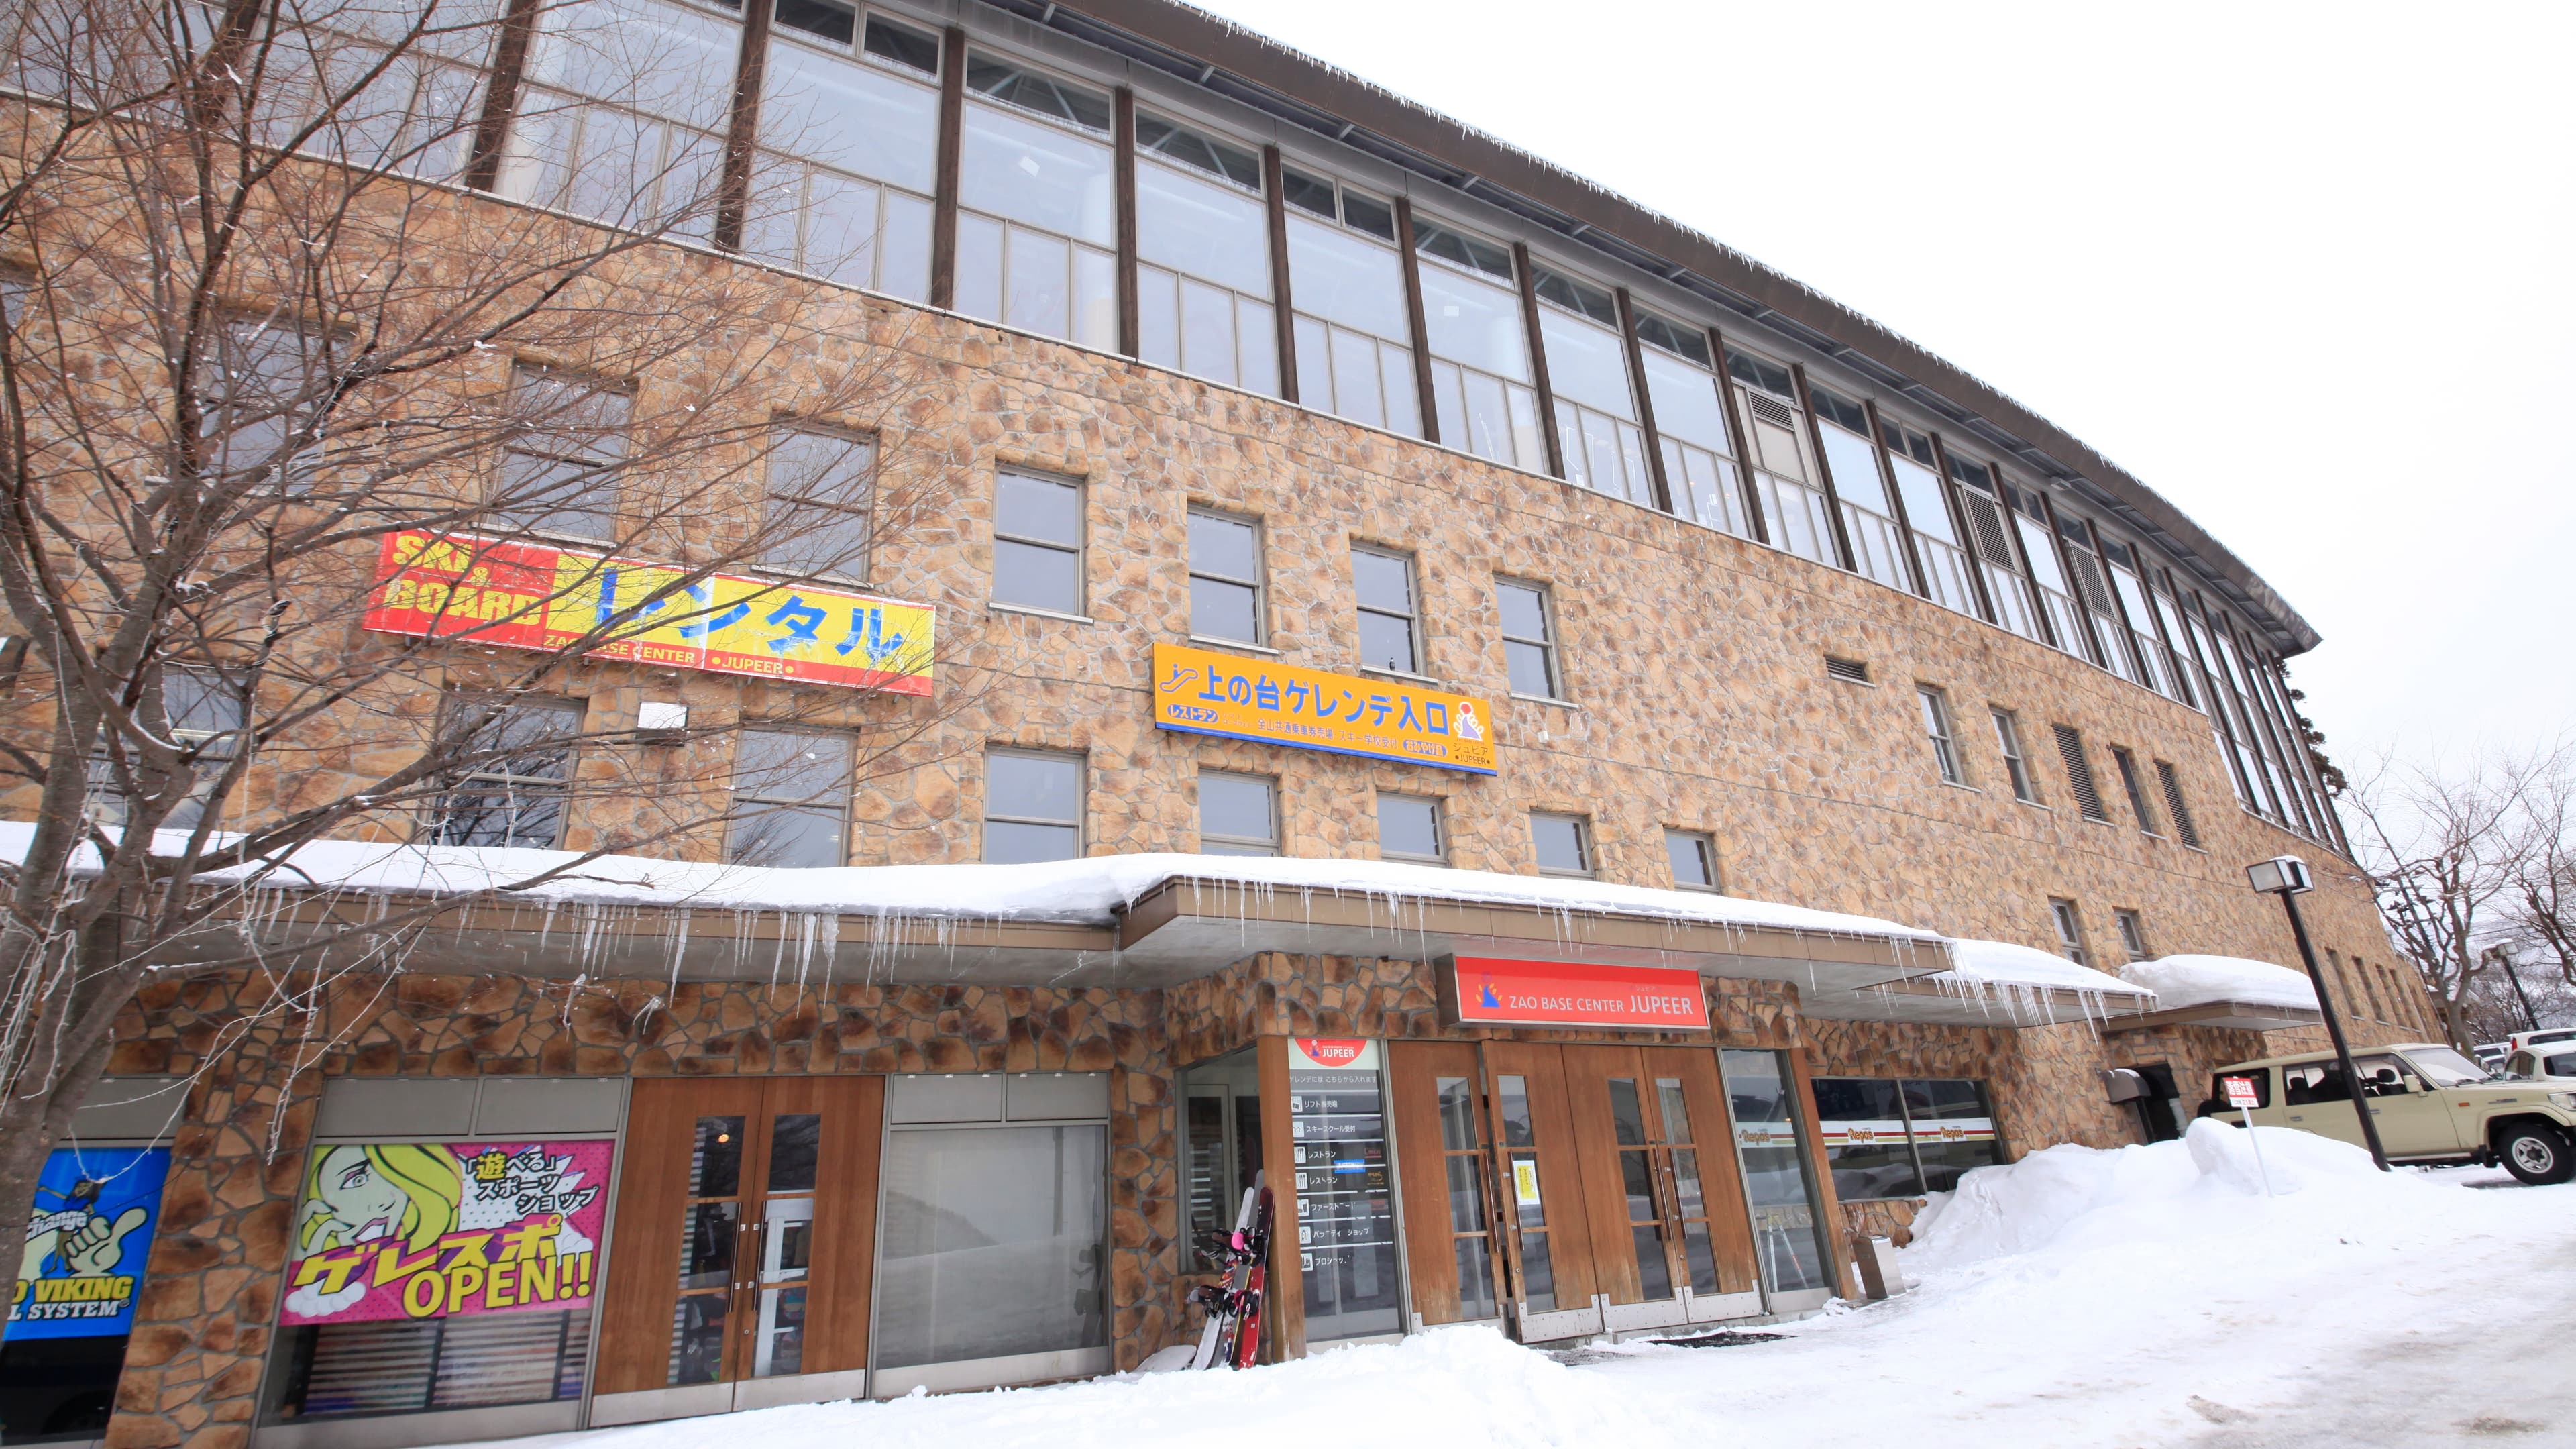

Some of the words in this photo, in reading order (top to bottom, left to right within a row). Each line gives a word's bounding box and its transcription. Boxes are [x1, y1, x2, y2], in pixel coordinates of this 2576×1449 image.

[393, 535, 472, 572] SKI
[470, 567, 490, 588] &
[384, 579, 543, 625] BOARD
[596, 568, 903, 660] レンタル
[633, 646, 696, 663] CENTER
[722, 657, 784, 675] JUPEER
[1198, 665, 1450, 736] 上の台ゲレンデ入口
[1170, 704, 1216, 722] レストラン
[1460, 753, 1487, 765] JUPEER
[1509, 996, 1538, 1009] ZAO
[1541, 997, 1573, 1011] BASE
[1576, 998, 1625, 1013] CENTER
[1630, 995, 1694, 1015] JUPEER
[1322, 1048, 1355, 1058] JUPEER
[1305, 1124, 1356, 1134] スキースクール受付
[1847, 1127, 1874, 1144] Repos
[1939, 1126, 1965, 1142] Repos
[1308, 1150, 1336, 1159] レストラン
[467, 1151, 557, 1181] 「遊べる」
[476, 1175, 560, 1201] スポーツ
[517, 1185, 600, 1214] ショップ
[292, 1213, 563, 1295] ゲレスポ
[35, 1276, 134, 1303] VIKING
[402, 1251, 592, 1318] OPEN!!
[27, 1301, 119, 1320] SYSTEM
